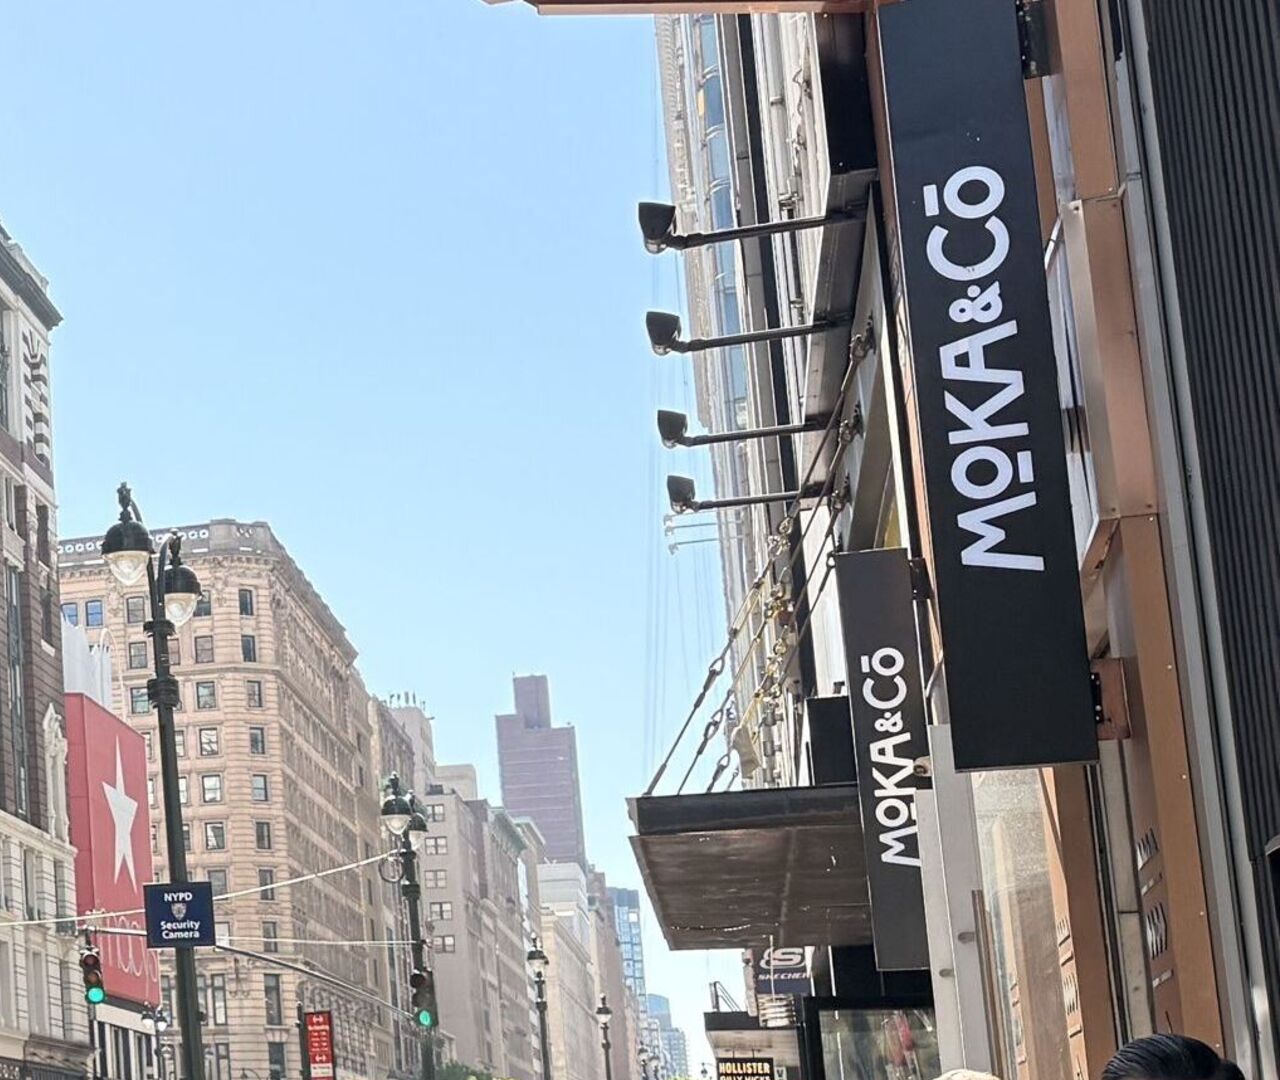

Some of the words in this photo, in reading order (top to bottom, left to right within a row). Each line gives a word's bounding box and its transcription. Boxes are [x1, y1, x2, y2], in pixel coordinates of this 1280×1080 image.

[164, 892, 192, 901] NYPD
[160, 920, 200, 931] Security
[161, 929, 200, 939] Camera
[719, 1062, 771, 1074] HOLLISTER
